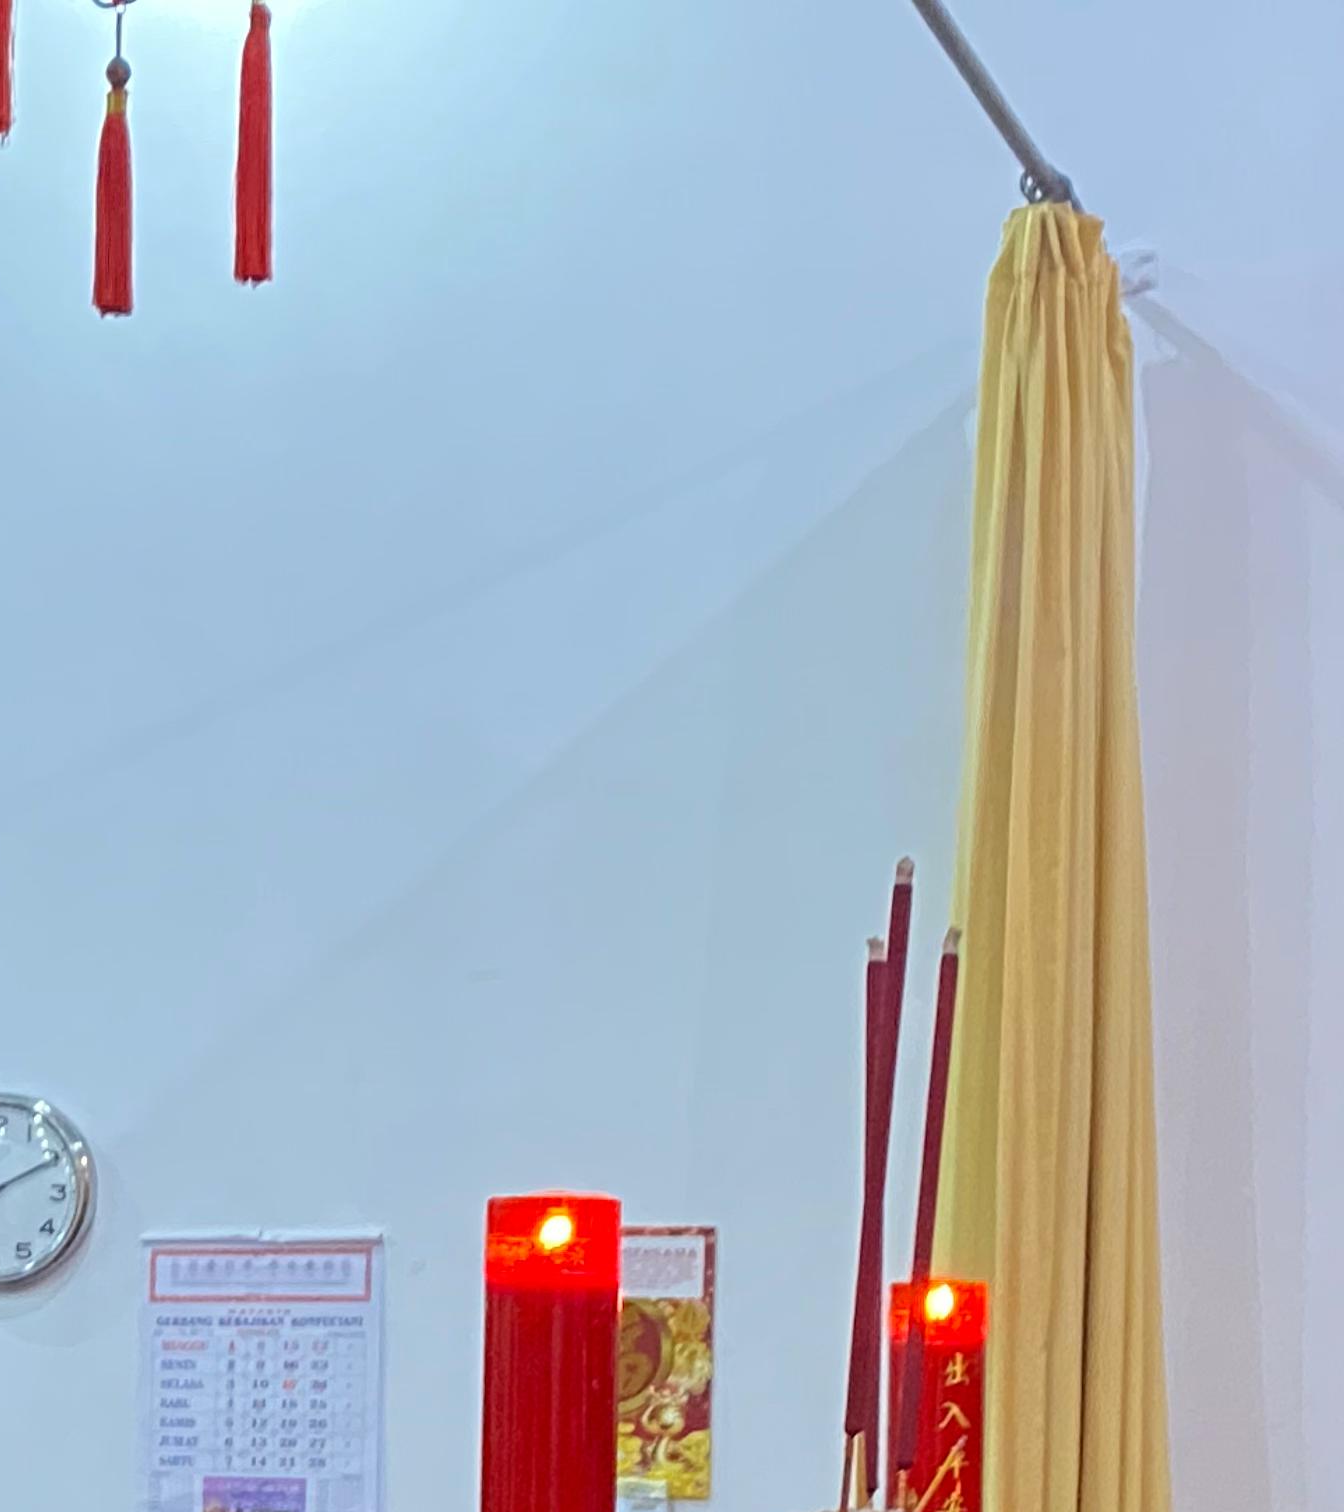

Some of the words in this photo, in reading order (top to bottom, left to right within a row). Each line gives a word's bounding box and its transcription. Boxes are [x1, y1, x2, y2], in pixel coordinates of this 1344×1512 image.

[50, 1183, 67, 1202] 3
[39, 1218, 55, 1235] 4
[16, 1242, 32, 1259] 5
